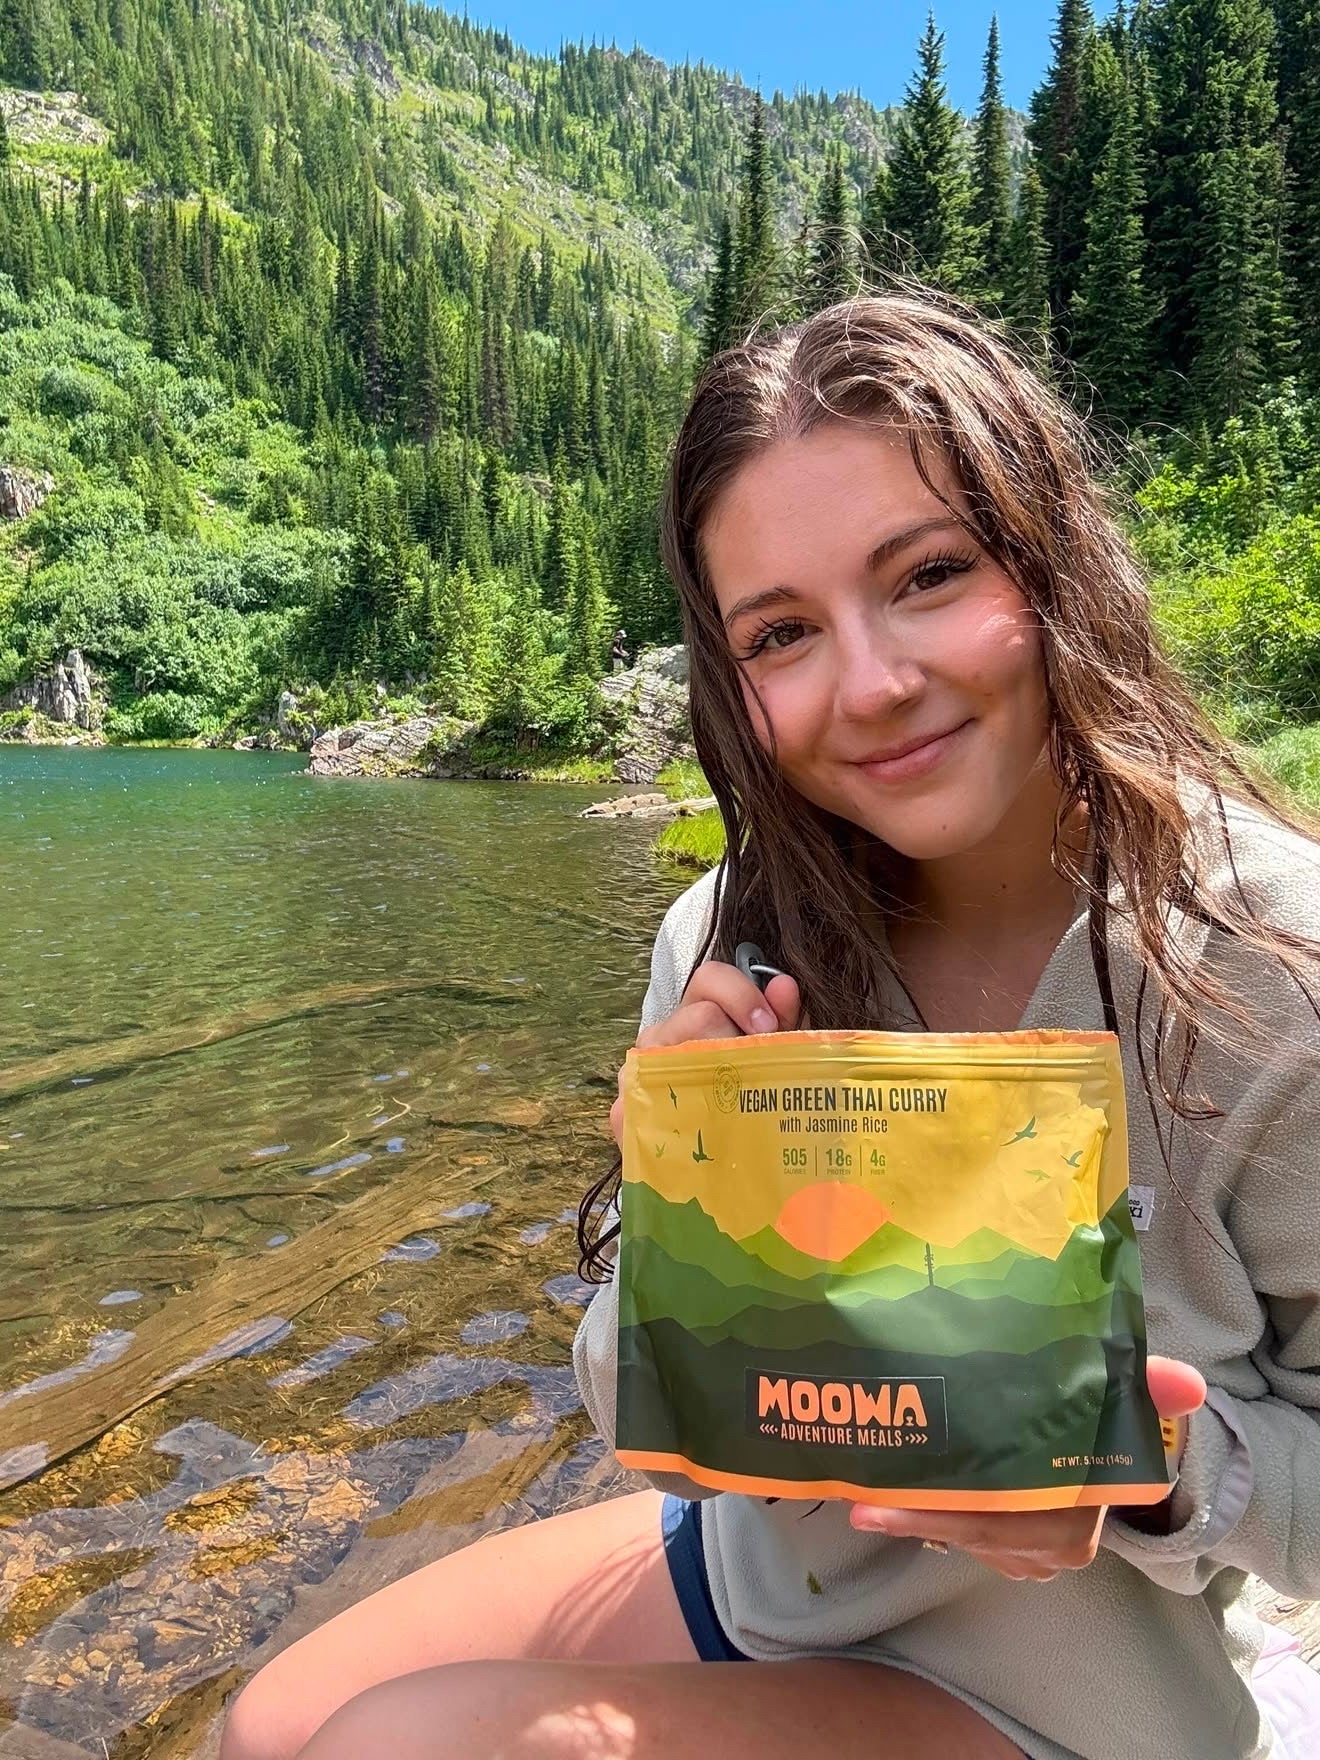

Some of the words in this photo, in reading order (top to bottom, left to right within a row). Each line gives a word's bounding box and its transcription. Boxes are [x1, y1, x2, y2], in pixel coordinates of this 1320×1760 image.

[739, 1088, 778, 1113] VEGAN
[782, 1087, 837, 1112] GREEN
[842, 1087, 883, 1112] THAI
[889, 1088, 948, 1112] CURRY
[779, 1116, 801, 1133] with
[805, 1116, 858, 1133] Jasmine
[862, 1116, 888, 1133] Rice
[782, 1148, 807, 1166] 505
[758, 1375, 928, 1428] MOOWA
[780, 1423, 853, 1446] ADVENTURE
[857, 1428, 903, 1447] MEALS
[1052, 1457, 1066, 1468] NET
[1068, 1456, 1082, 1467] WT.
[1106, 1454, 1133, 1467] (145g)
